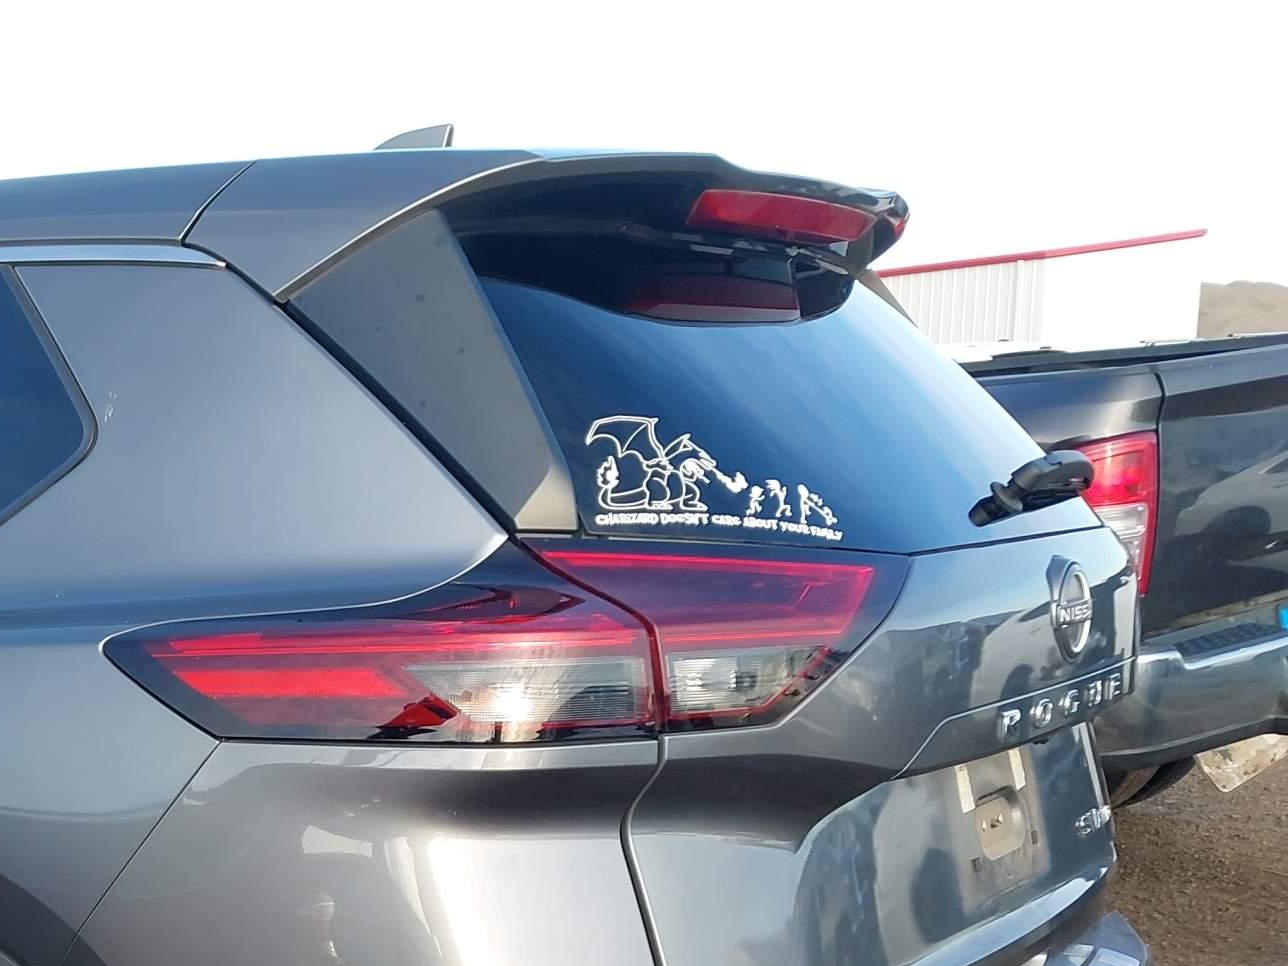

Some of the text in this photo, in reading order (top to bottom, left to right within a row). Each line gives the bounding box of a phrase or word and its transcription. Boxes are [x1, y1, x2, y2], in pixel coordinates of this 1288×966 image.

[711, 513, 742, 527] CARE
[743, 515, 779, 531] ABOUT
[780, 520, 811, 535] YOUR
[999, 672, 1122, 738] ROGUE
